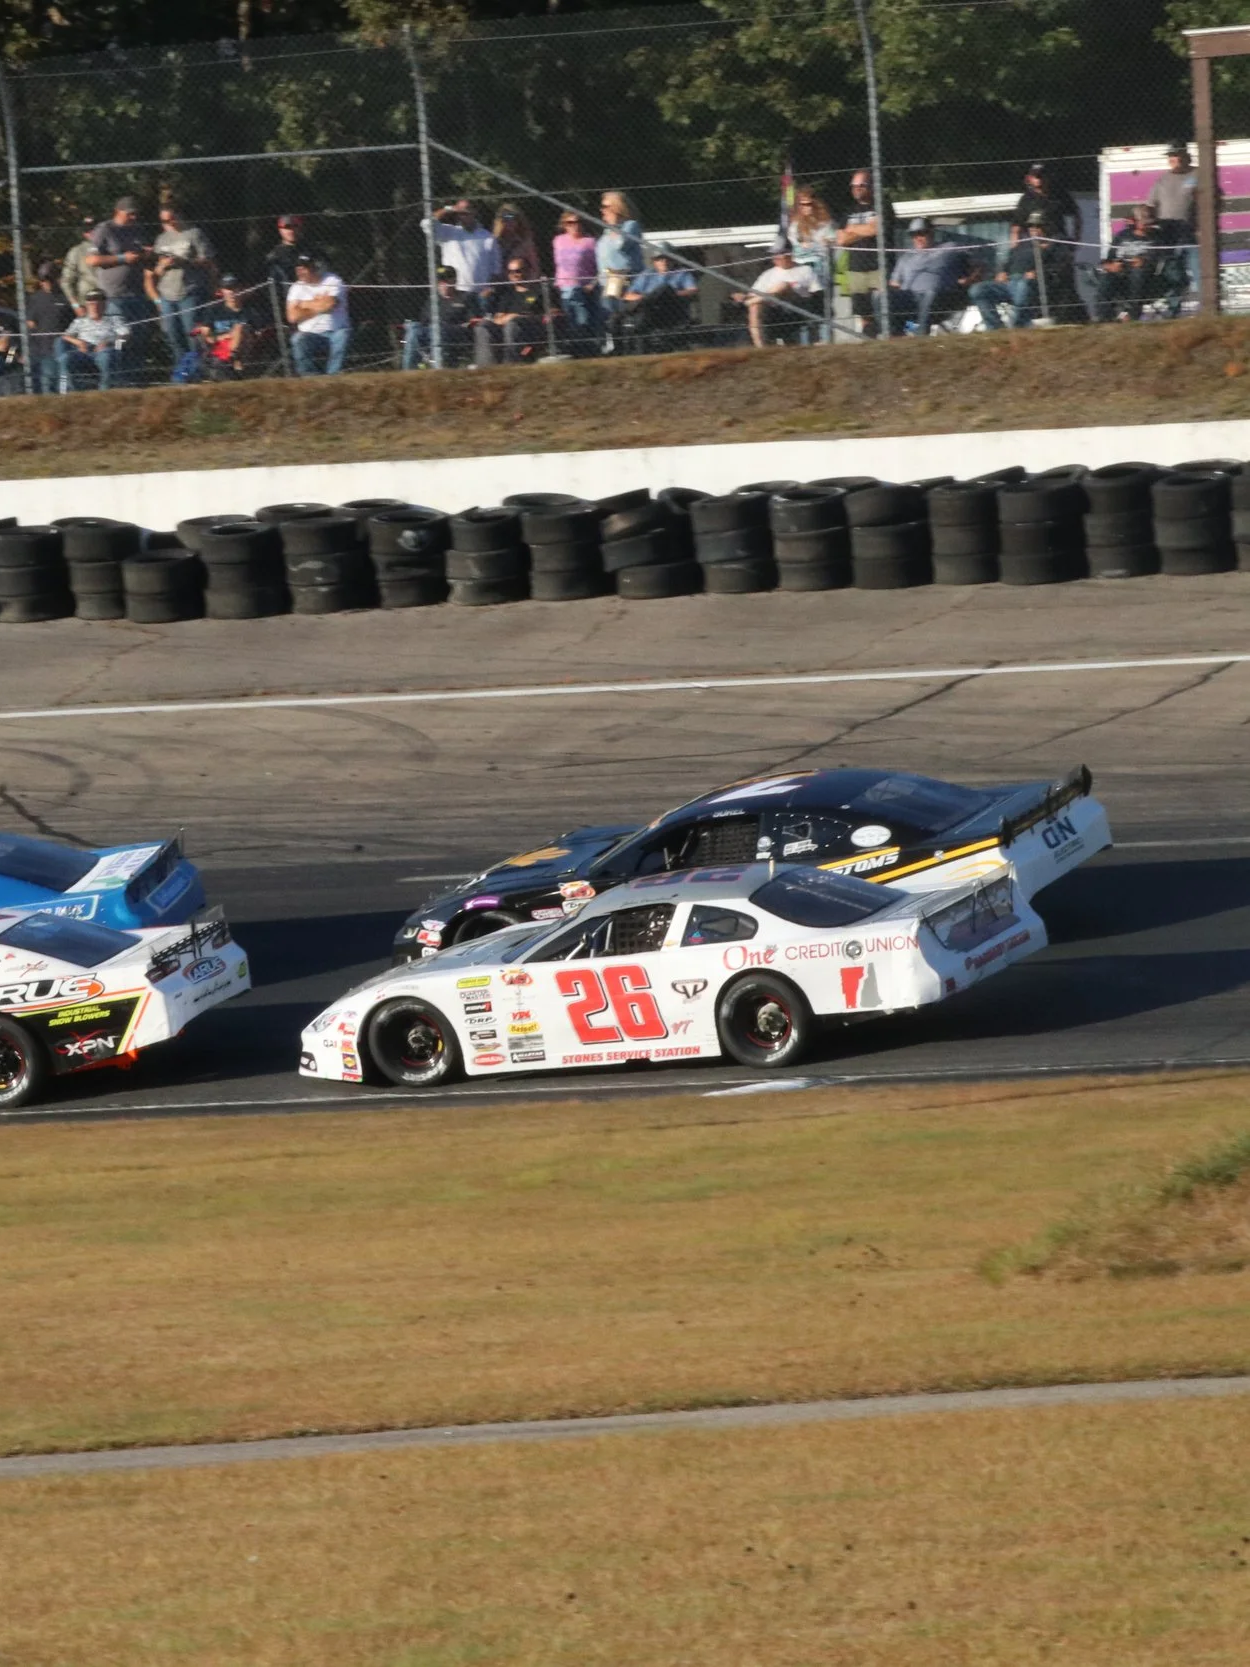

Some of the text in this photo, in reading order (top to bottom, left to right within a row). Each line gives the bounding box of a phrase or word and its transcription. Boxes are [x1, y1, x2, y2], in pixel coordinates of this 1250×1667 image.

[723, 935, 918, 970] One CREDIT UNION
[58, 1006, 100, 1017] INDUSTRIAL
[554, 964, 668, 1045] 26
[49, 1010, 110, 1026] SNOW BLOWERS
[64, 1035, 120, 1057] XPN
[562, 1045, 700, 1064] STONES SERVICE STATION
